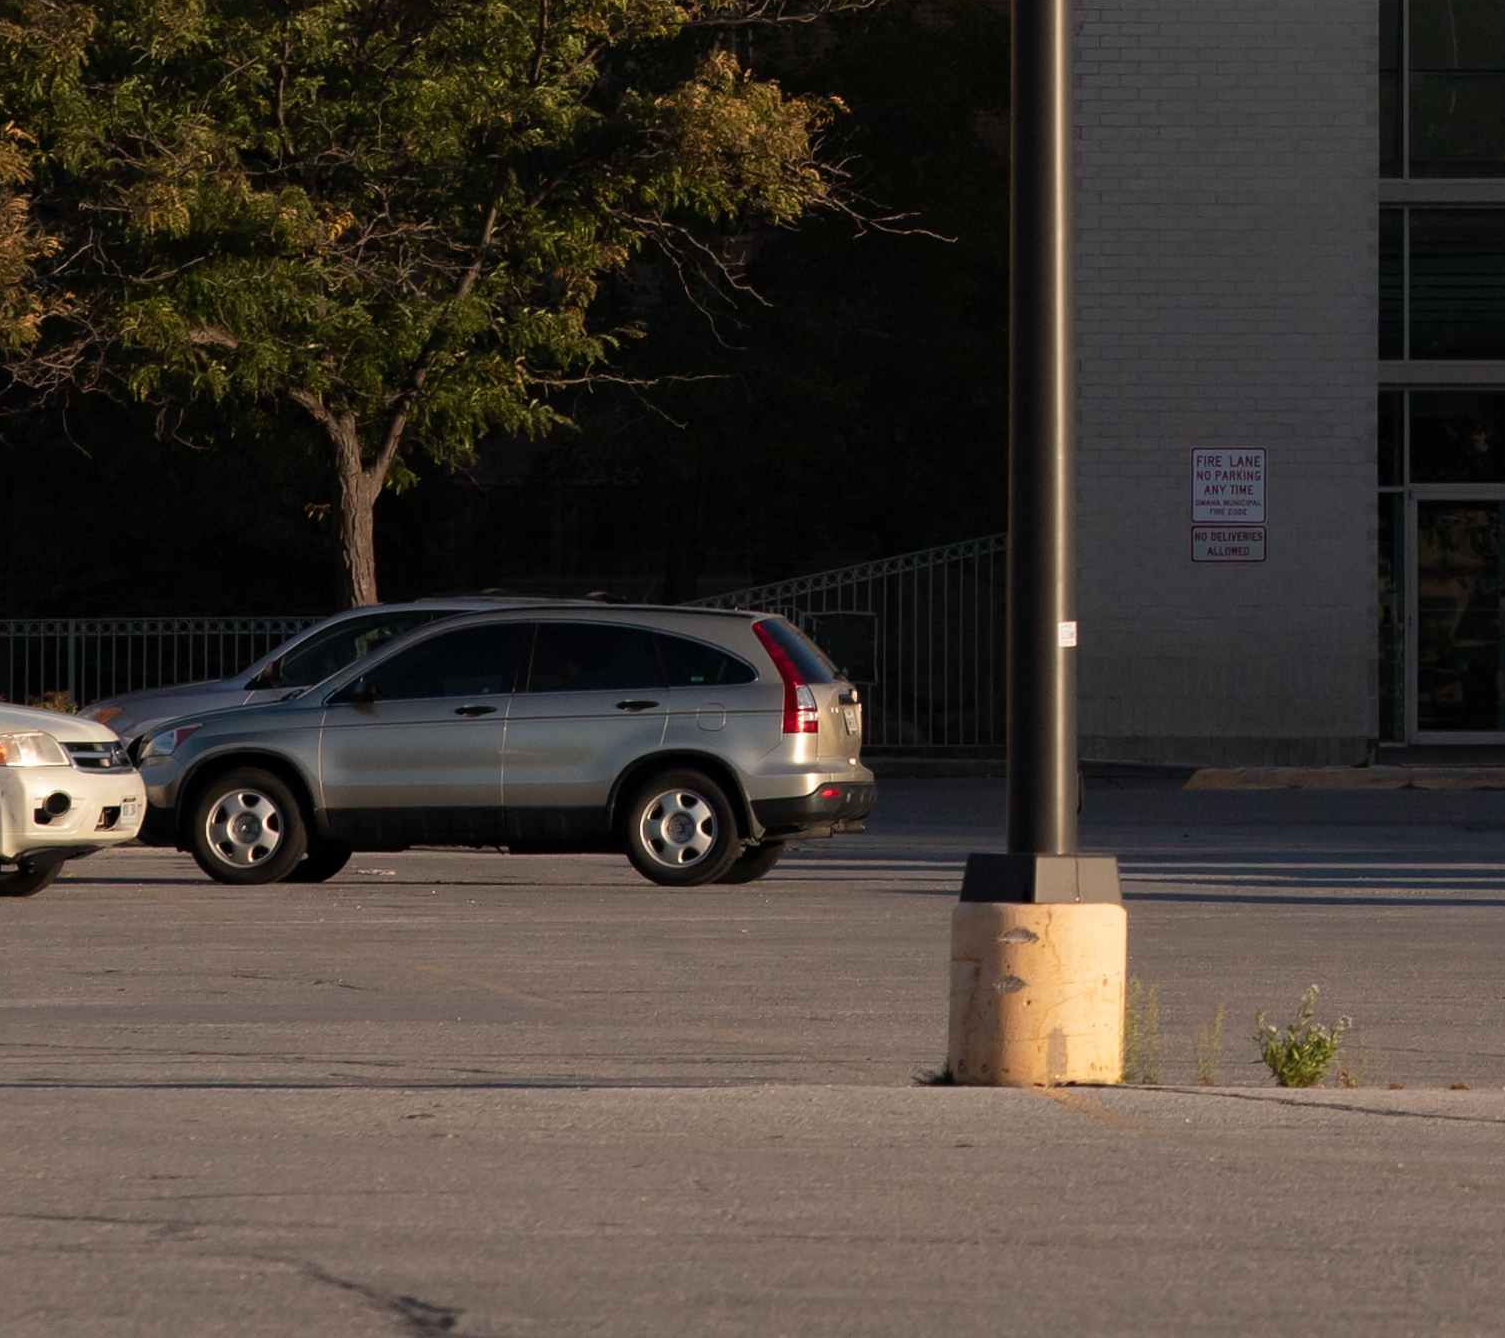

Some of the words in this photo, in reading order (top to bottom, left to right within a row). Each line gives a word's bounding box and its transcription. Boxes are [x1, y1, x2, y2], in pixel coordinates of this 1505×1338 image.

[1196, 455, 1222, 468] FIRE
[1229, 455, 1261, 468] LANE
[1196, 470, 1212, 482] NO
[1215, 470, 1262, 482] PARKING
[1203, 484, 1227, 496] ANY
[1229, 484, 1254, 496] TIME
[1195, 499, 1221, 507] OMAHA
[1223, 499, 1262, 507] MUNICIPAL
[1209, 508, 1225, 516] FIRE
[1227, 508, 1248, 516] CODE
[1194, 531, 1208, 542] NO
[1210, 531, 1263, 542] DELIVERIES
[1206, 546, 1250, 557] ALLOWED
